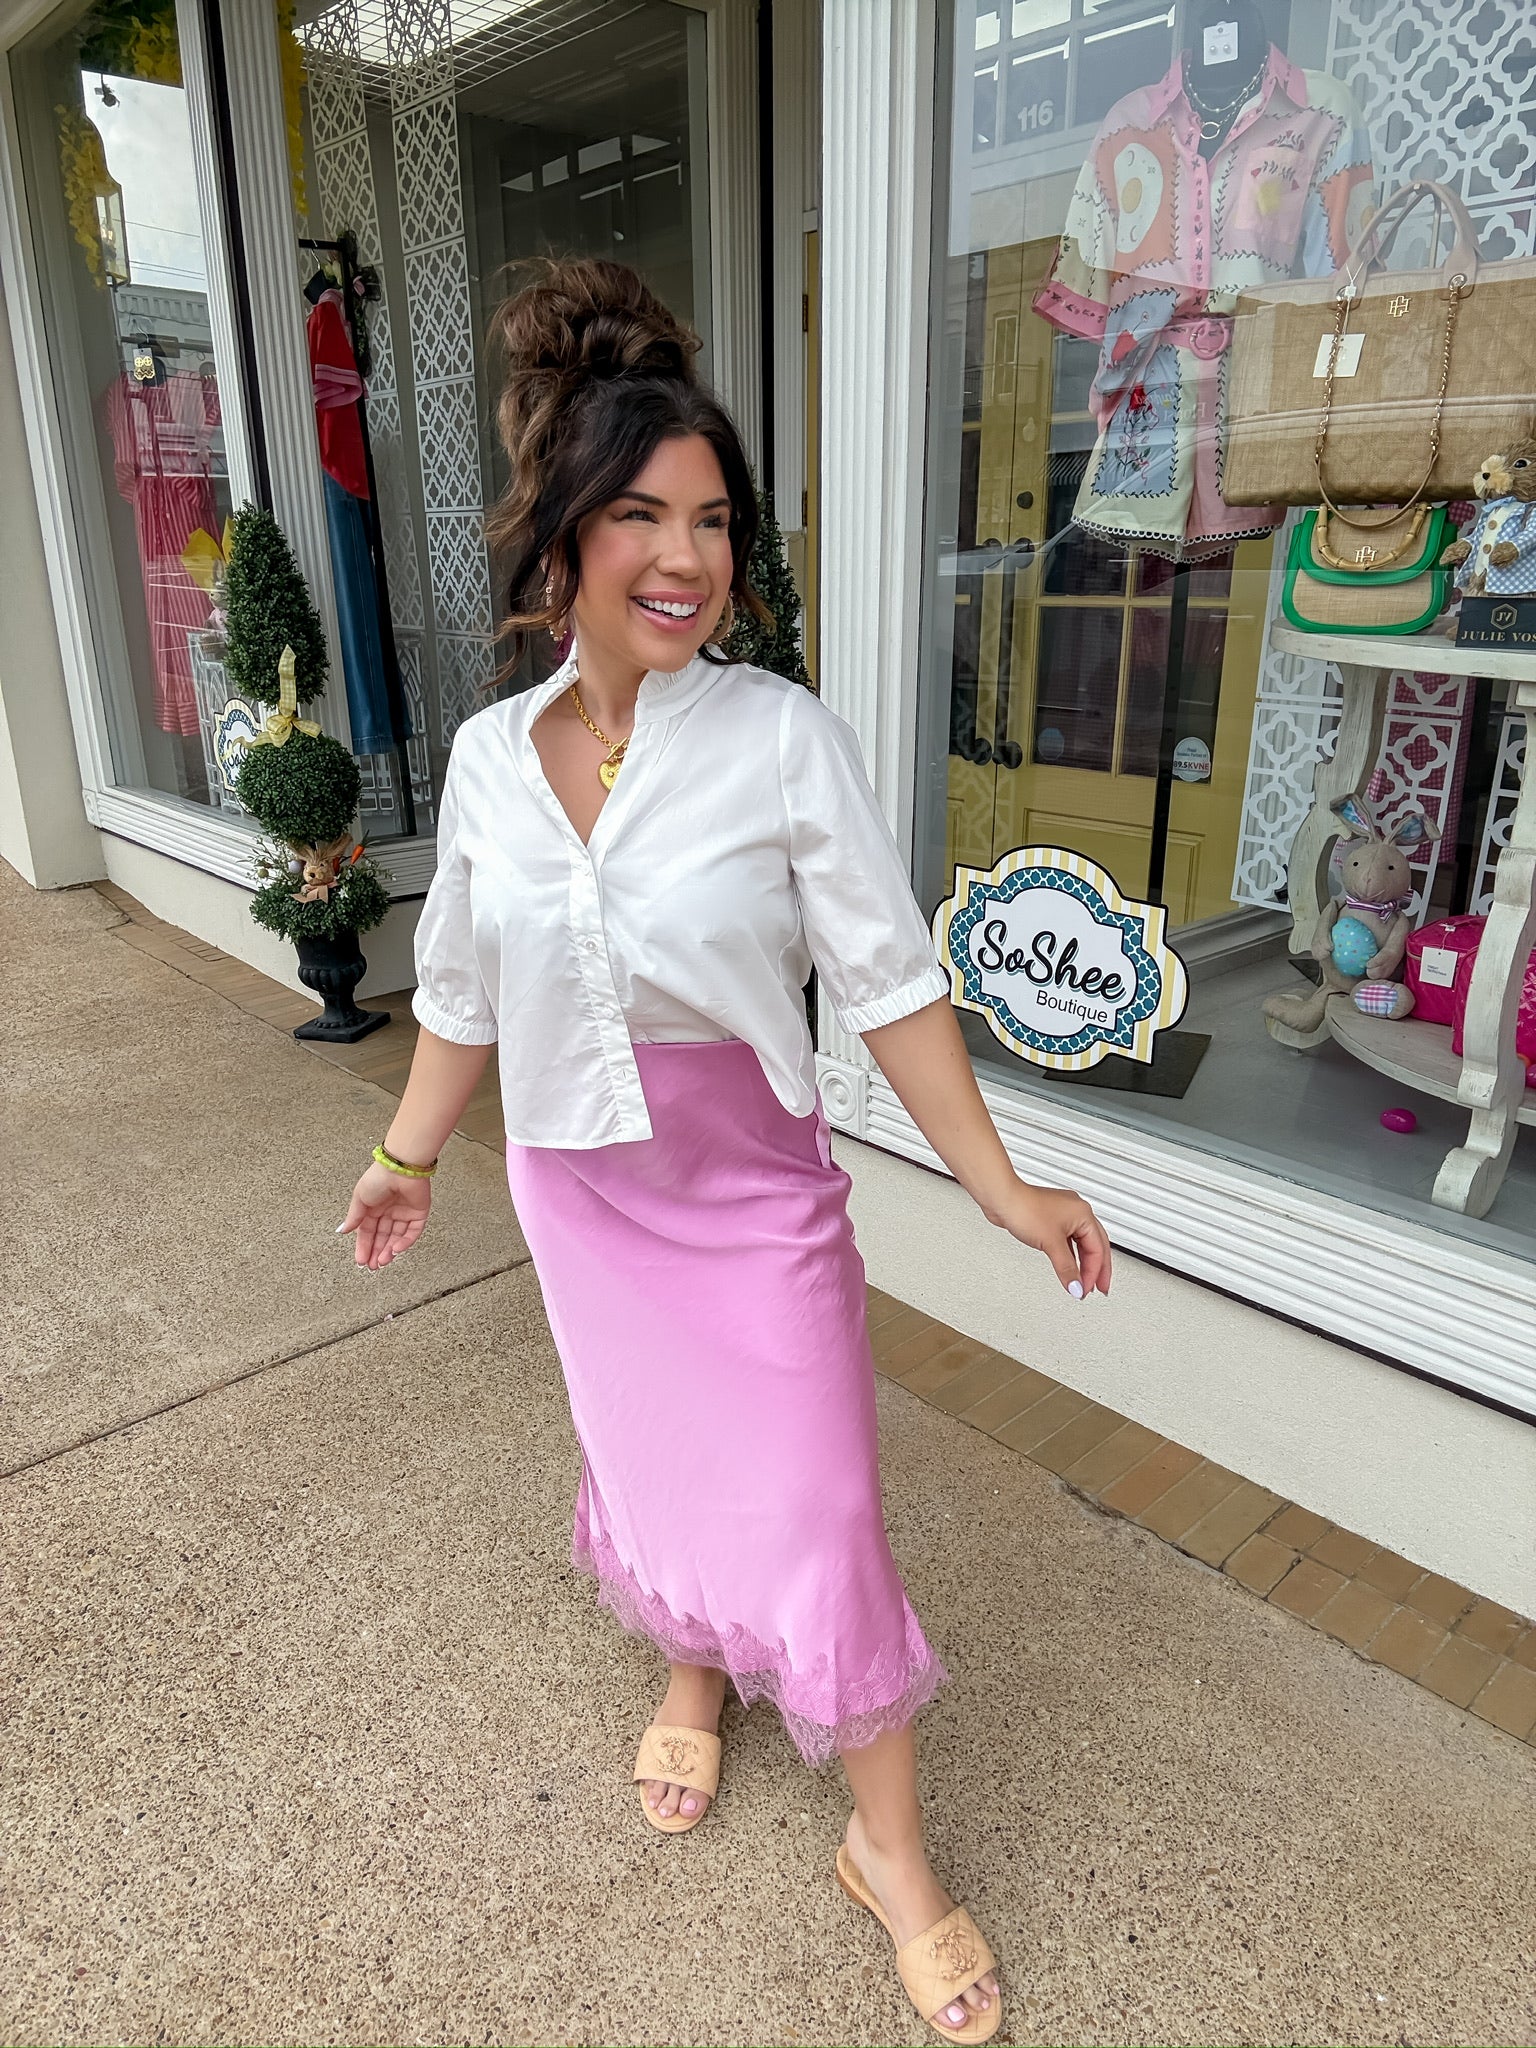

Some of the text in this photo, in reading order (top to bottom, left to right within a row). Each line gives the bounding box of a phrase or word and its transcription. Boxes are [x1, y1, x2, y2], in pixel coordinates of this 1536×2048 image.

[1018, 100, 1053, 131] 116
[1496, 612, 1512, 622] JV
[1461, 630, 1506, 642] JULIE
[977, 919, 1126, 1002] SoShee
[1036, 990, 1108, 1023] Boutique
